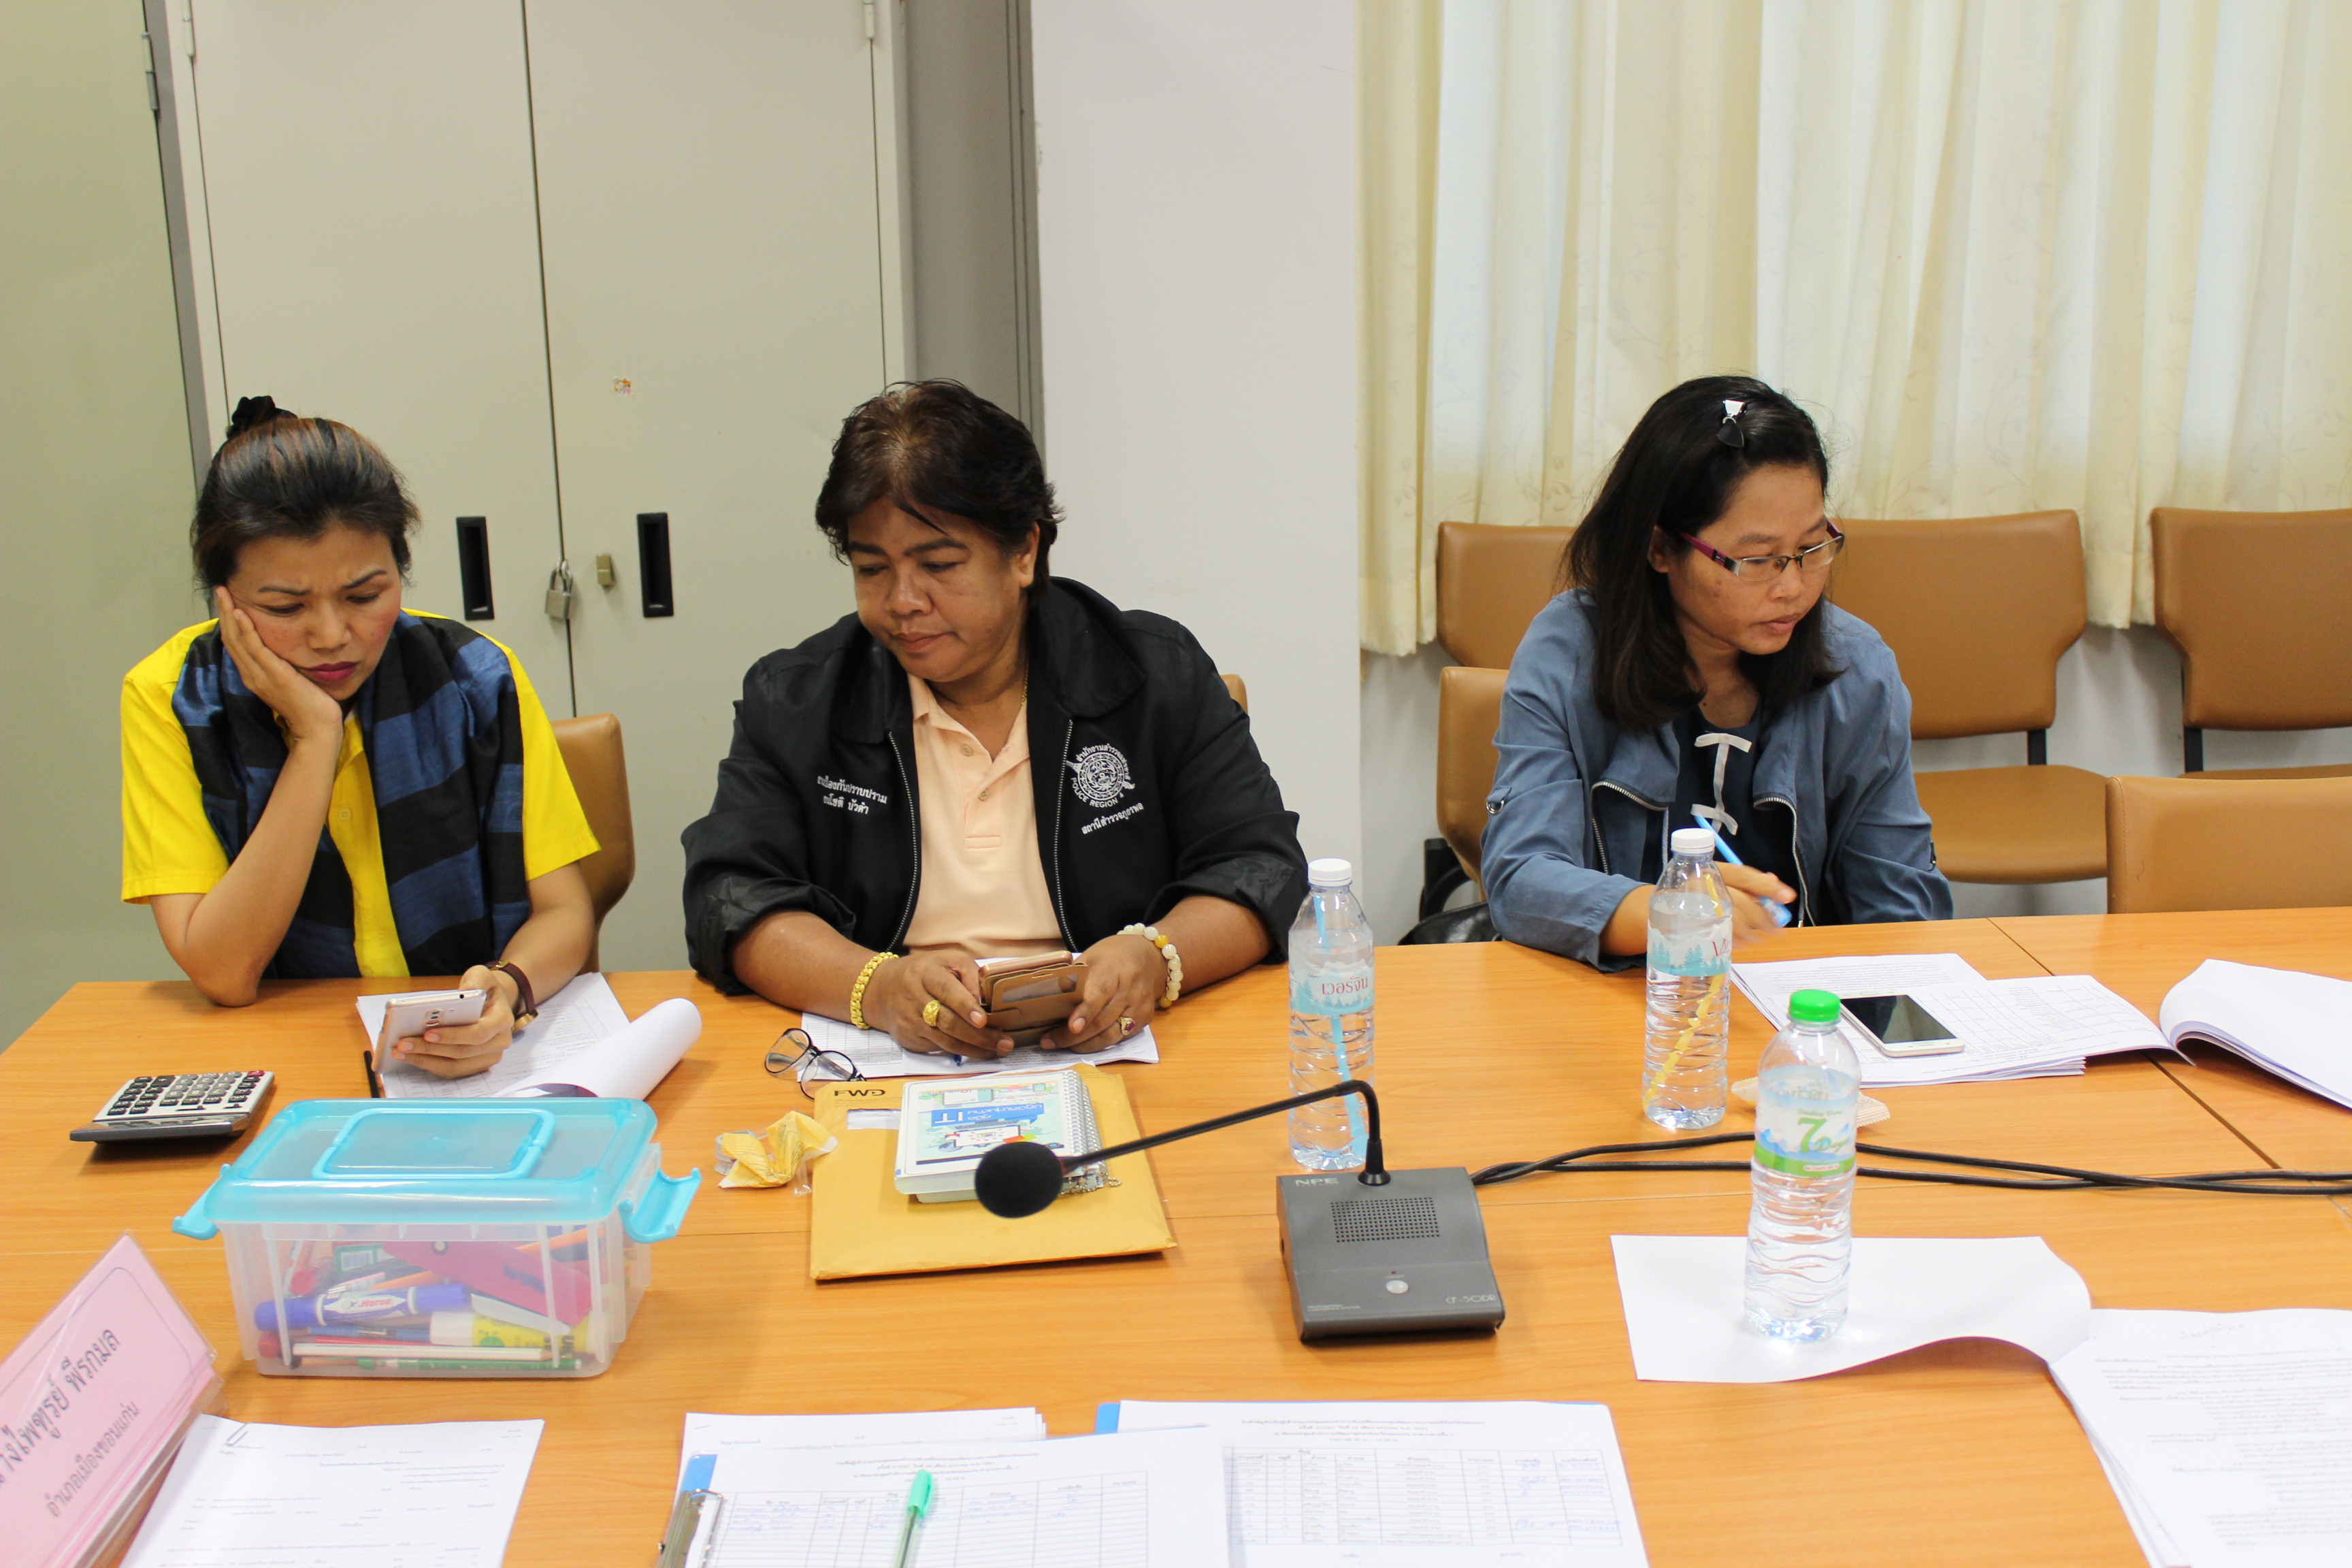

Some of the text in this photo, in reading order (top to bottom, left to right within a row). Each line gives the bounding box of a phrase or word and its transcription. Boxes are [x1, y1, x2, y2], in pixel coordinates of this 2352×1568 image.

[1071, 777, 1089, 802] POLICE
[1089, 798, 1118, 808] REGION
[1320, 975, 1369, 995] เวอร์จิน
[934, 1111, 964, 1124] IT
[1797, 1117, 1827, 1153] 7
[1295, 1177, 1339, 1186] NPE
[359, 1298, 392, 1308] Horse
[44, 1401, 140, 1518] อำเภอเมืองขอนแก่น
